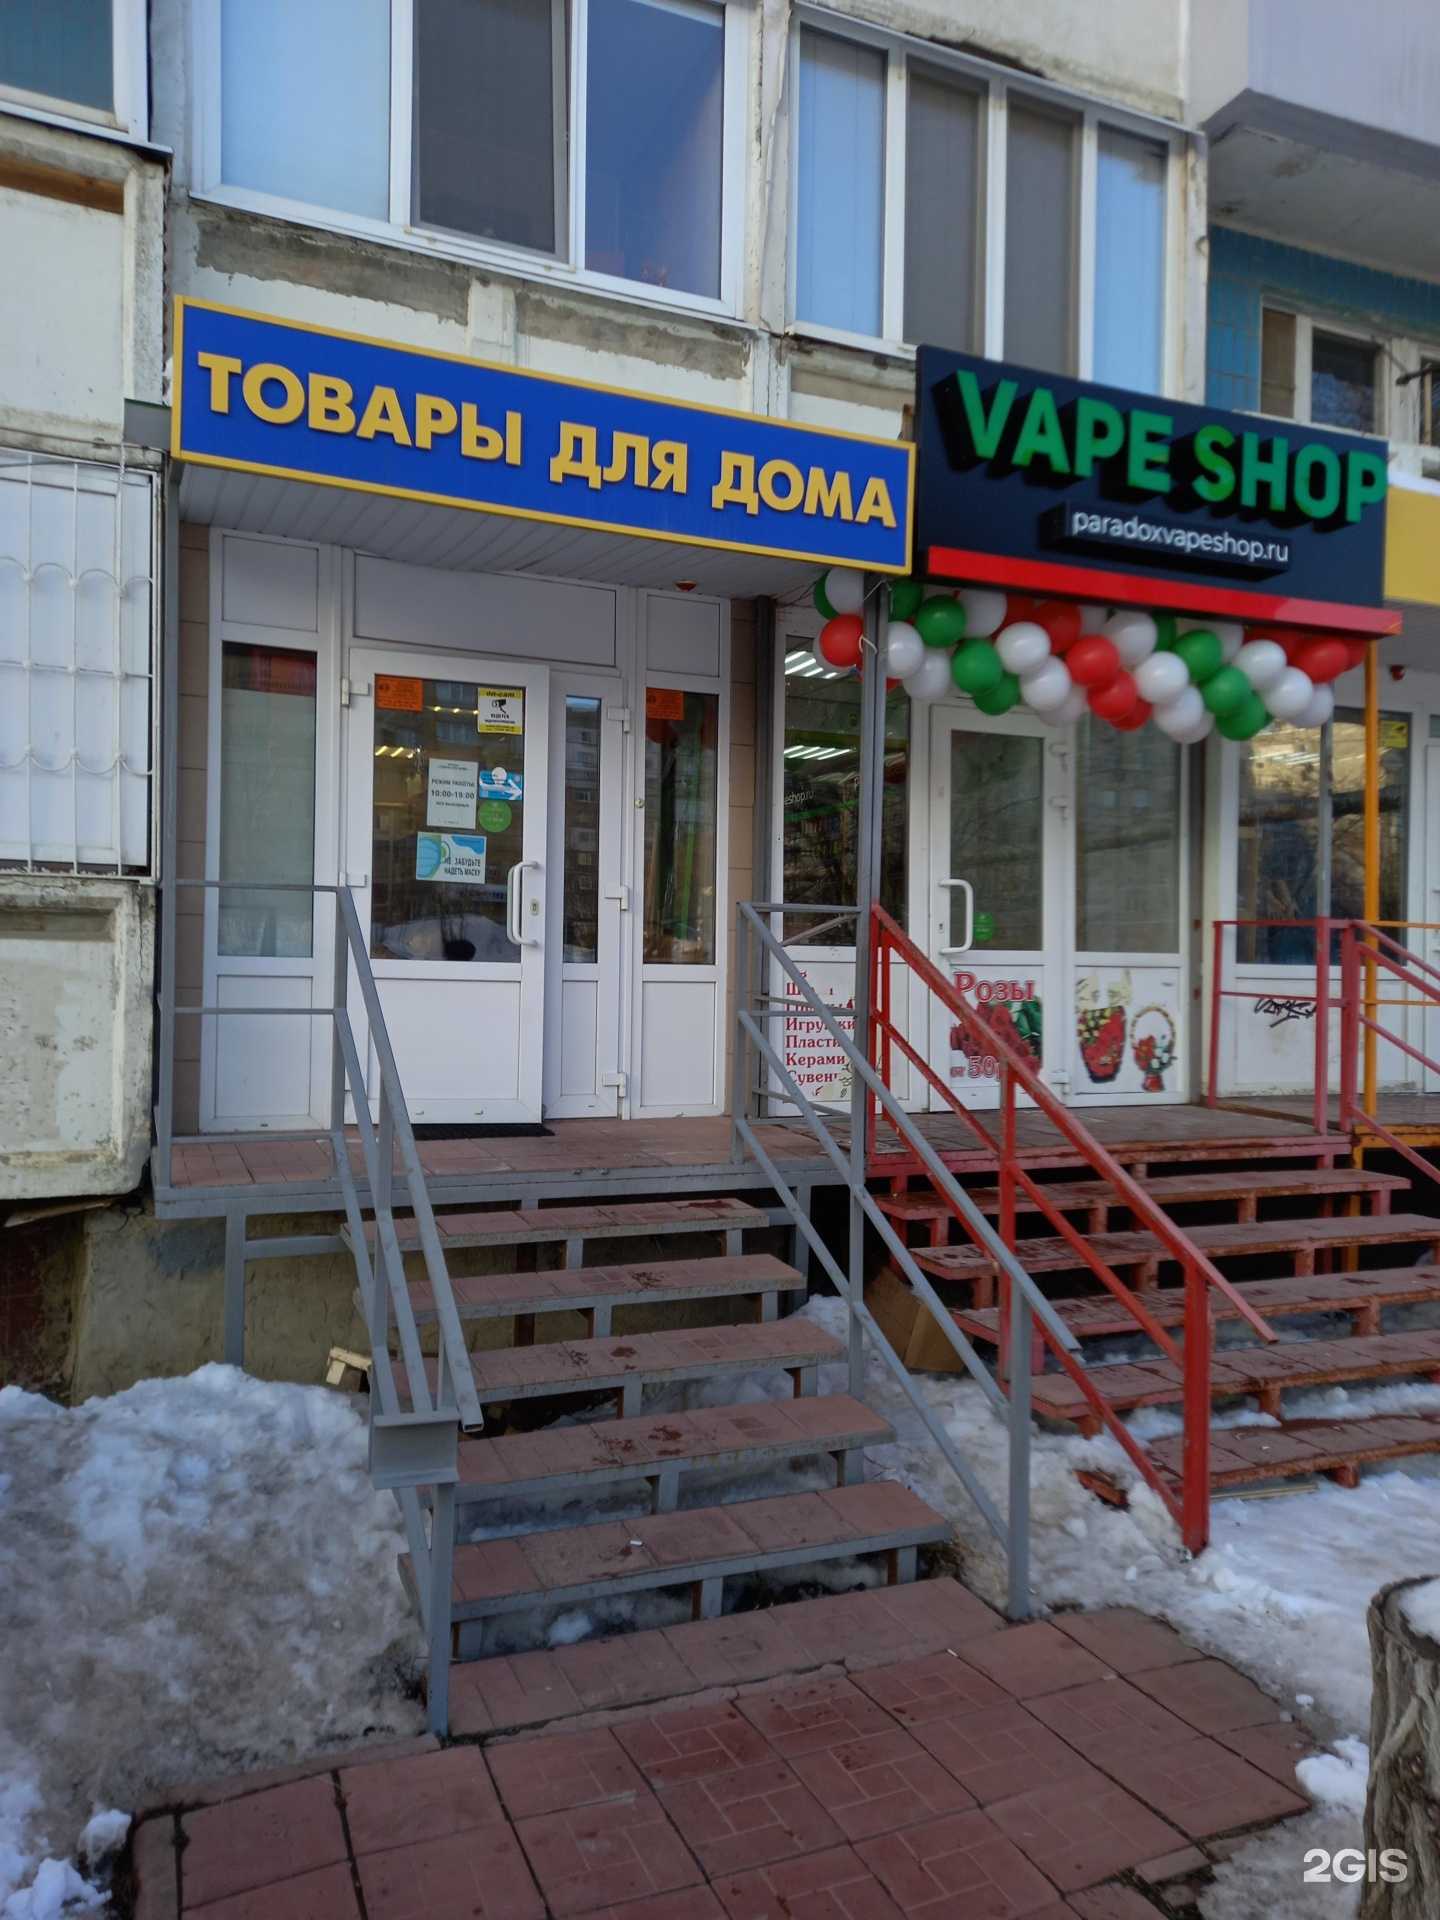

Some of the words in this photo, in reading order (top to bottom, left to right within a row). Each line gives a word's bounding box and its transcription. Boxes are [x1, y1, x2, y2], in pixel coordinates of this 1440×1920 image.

[198, 351, 522, 467] ТОВАРЫ
[549, 421, 688, 494] ДЛЯ
[711, 450, 898, 529] ДОМА
[956, 369, 1174, 493] VAPE
[1192, 424, 1388, 524] SHOP
[1072, 509, 1289, 563] paradoxvapeshop.ru
[953, 971, 1034, 1004] Розы
[786, 1017, 857, 1034] Игруки
